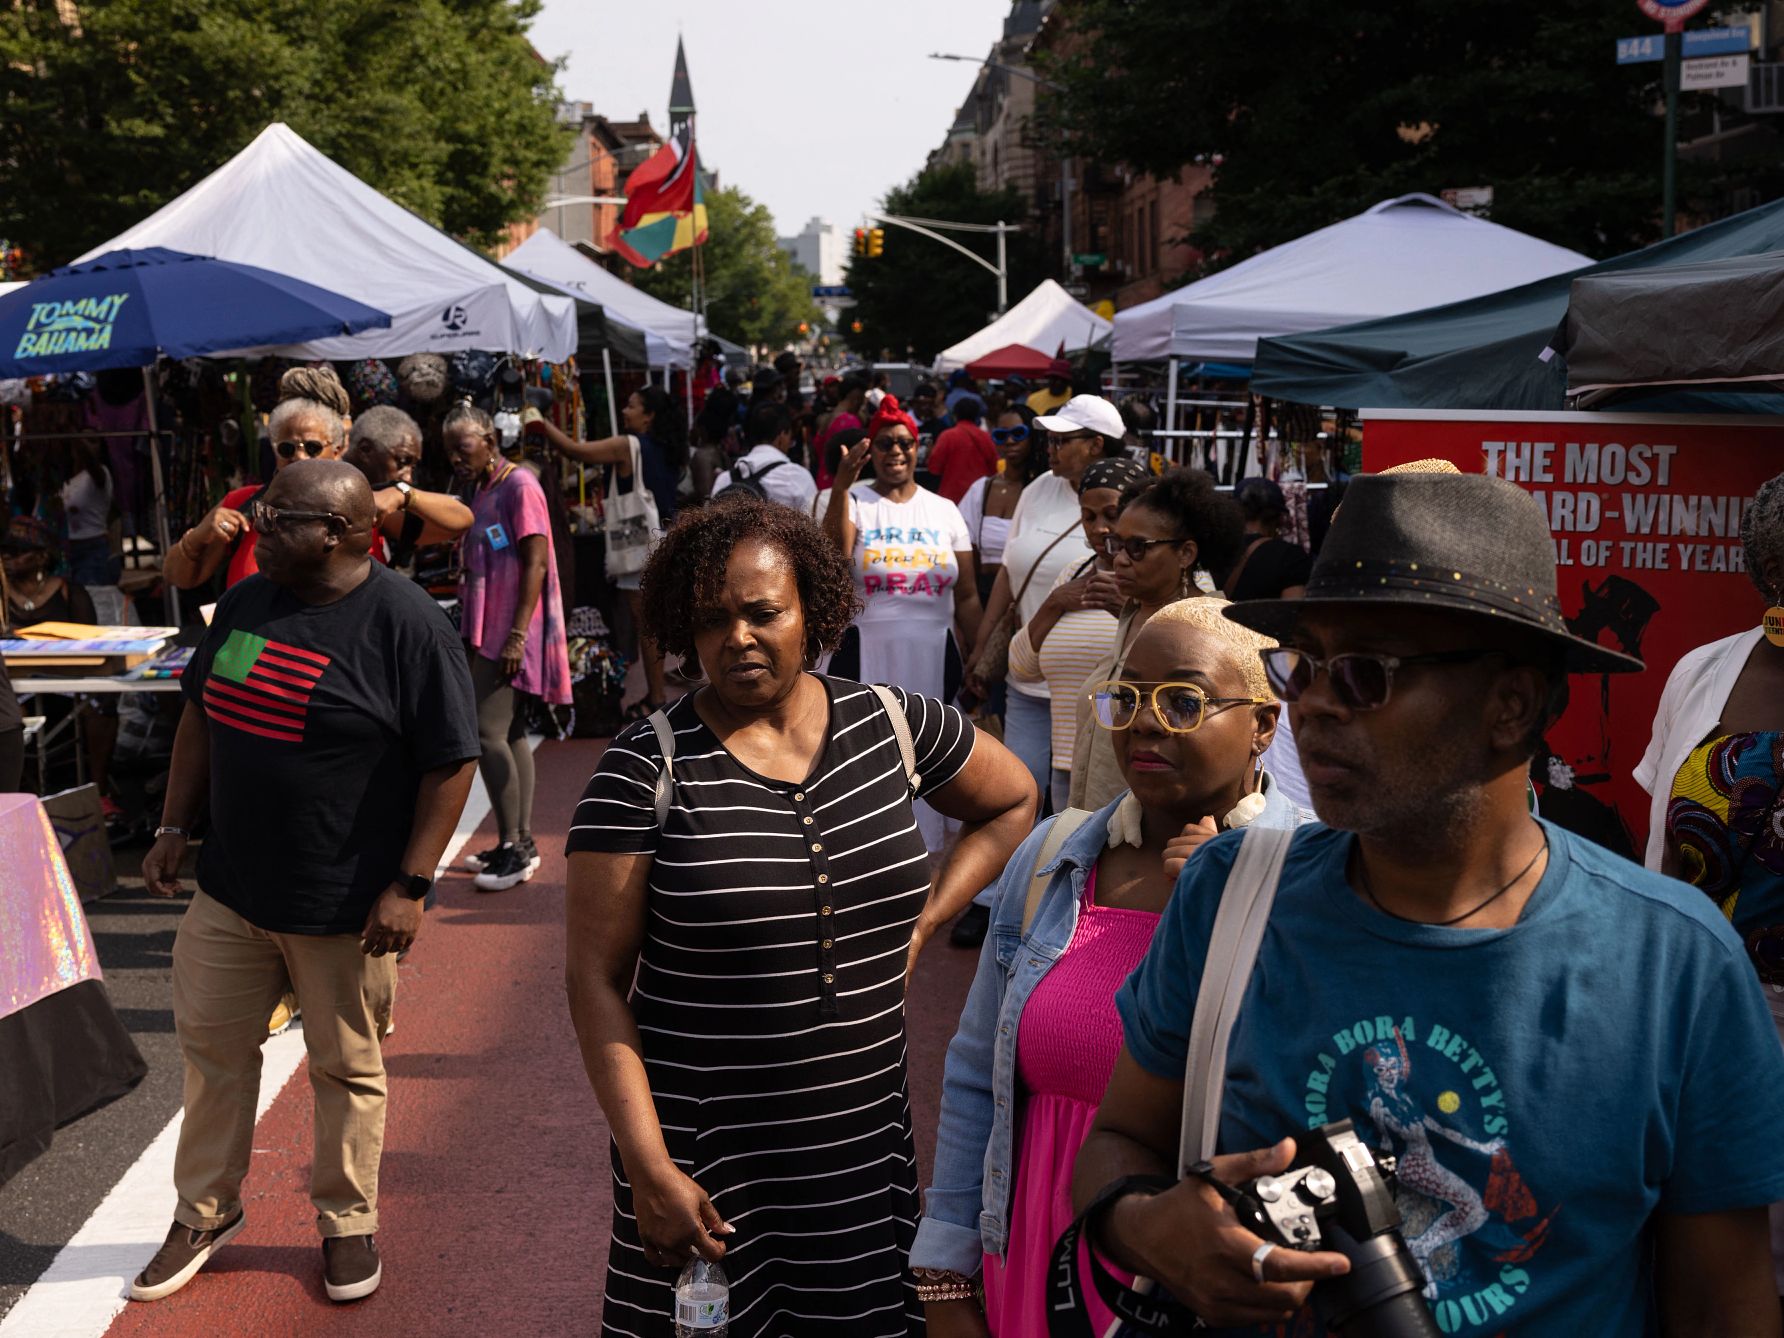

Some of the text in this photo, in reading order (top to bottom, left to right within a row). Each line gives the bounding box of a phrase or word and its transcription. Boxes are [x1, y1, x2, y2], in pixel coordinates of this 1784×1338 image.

[26, 292, 130, 331] TOMMY
[13, 321, 114, 360] BAHAMA
[1481, 440, 1678, 487] THE MOST
[863, 526, 940, 547] PRAY
[862, 547, 948, 571] PRAY
[872, 554, 915, 565] over
[1580, 539, 1614, 567] OF
[1620, 541, 1670, 570] THE
[1677, 543, 1746, 574] YEAR
[863, 571, 953, 597] PRAY
[1305, 1052, 1337, 1130] BORA
[1332, 1015, 1416, 1056] BORA
[1433, 1264, 1530, 1334] OURS
